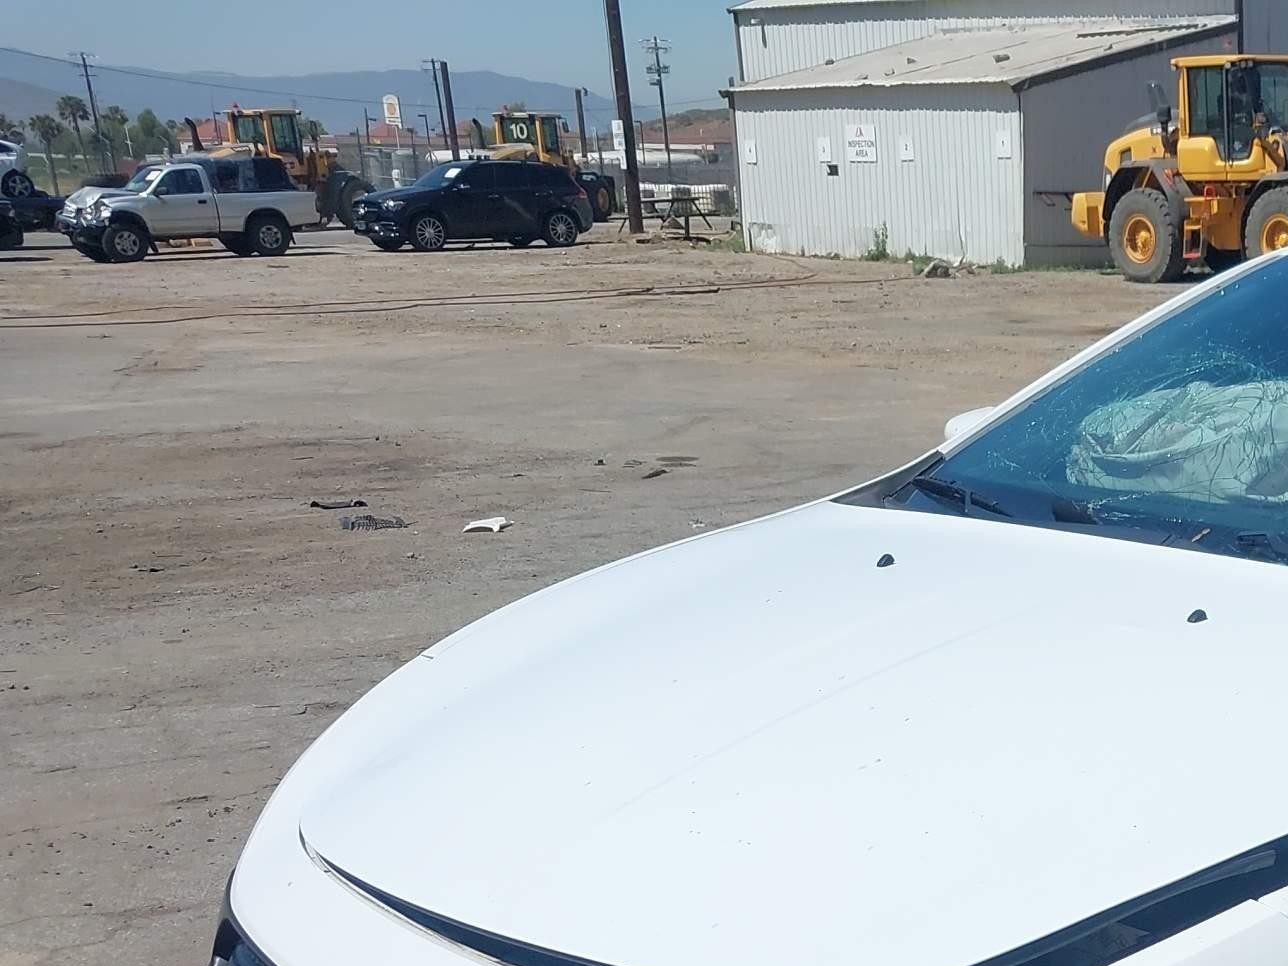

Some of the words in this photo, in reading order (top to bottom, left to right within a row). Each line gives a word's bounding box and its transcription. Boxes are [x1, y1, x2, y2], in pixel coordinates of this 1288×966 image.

[510, 123, 528, 139] 10
[848, 140, 875, 148] INSPECTION
[855, 150, 869, 158] AREA
